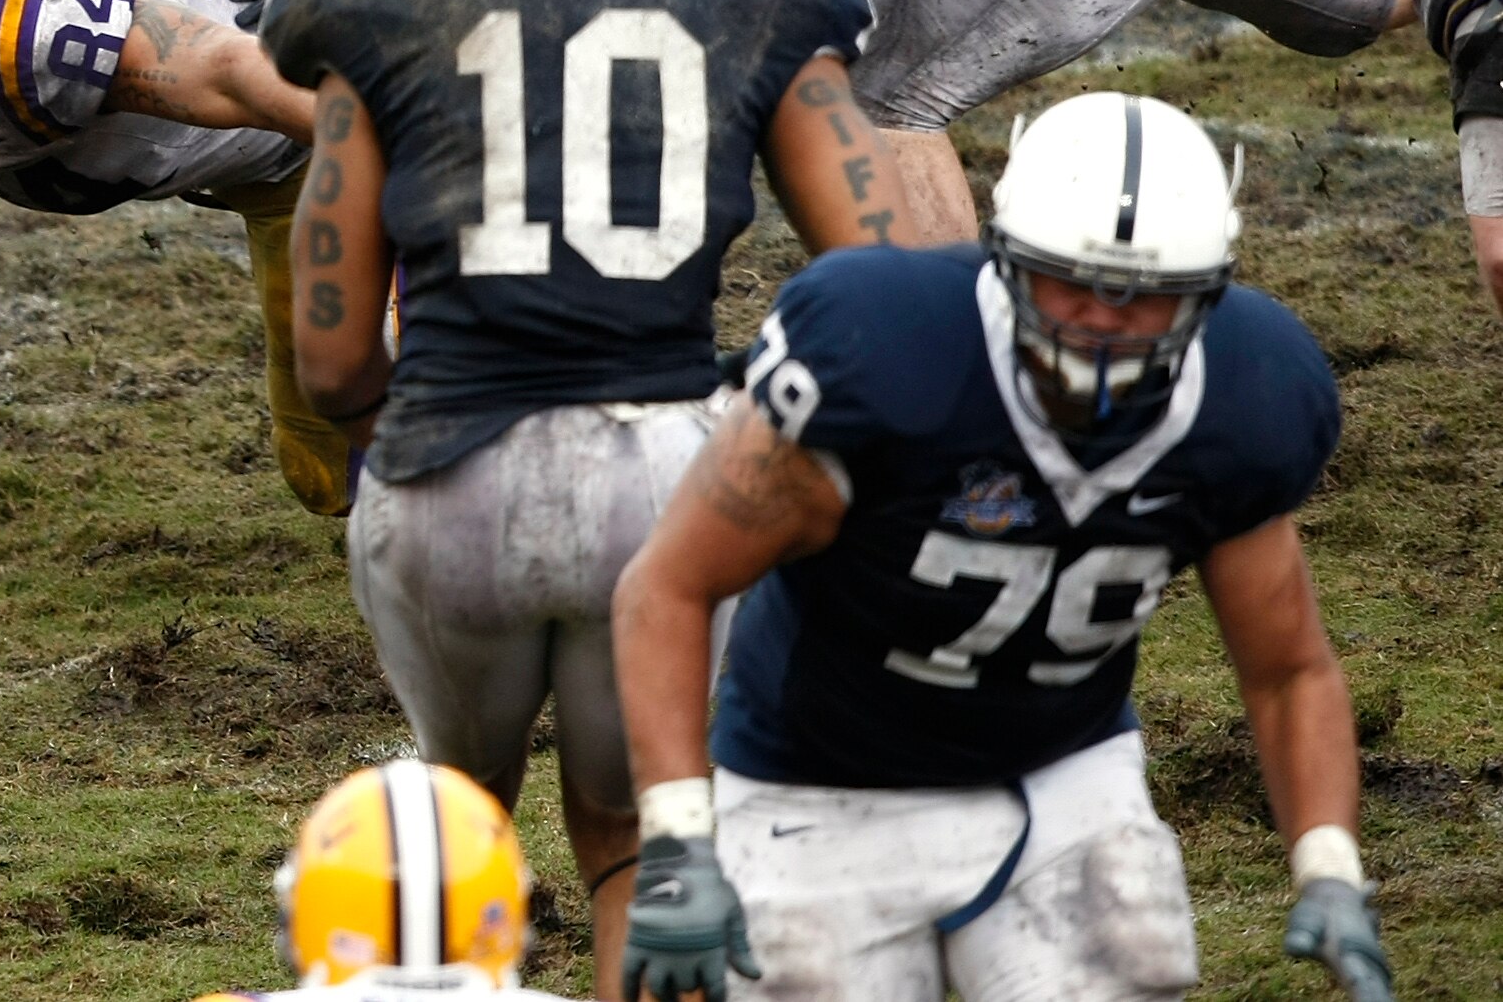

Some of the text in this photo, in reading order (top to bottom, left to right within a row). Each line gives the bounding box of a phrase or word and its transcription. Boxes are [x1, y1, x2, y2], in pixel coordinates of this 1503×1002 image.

[306, 96, 355, 330] GODS
[456, 9, 707, 280] 10
[798, 76, 894, 246] GIFT
[744, 310, 822, 441] 79
[884, 530, 1173, 690] 79
